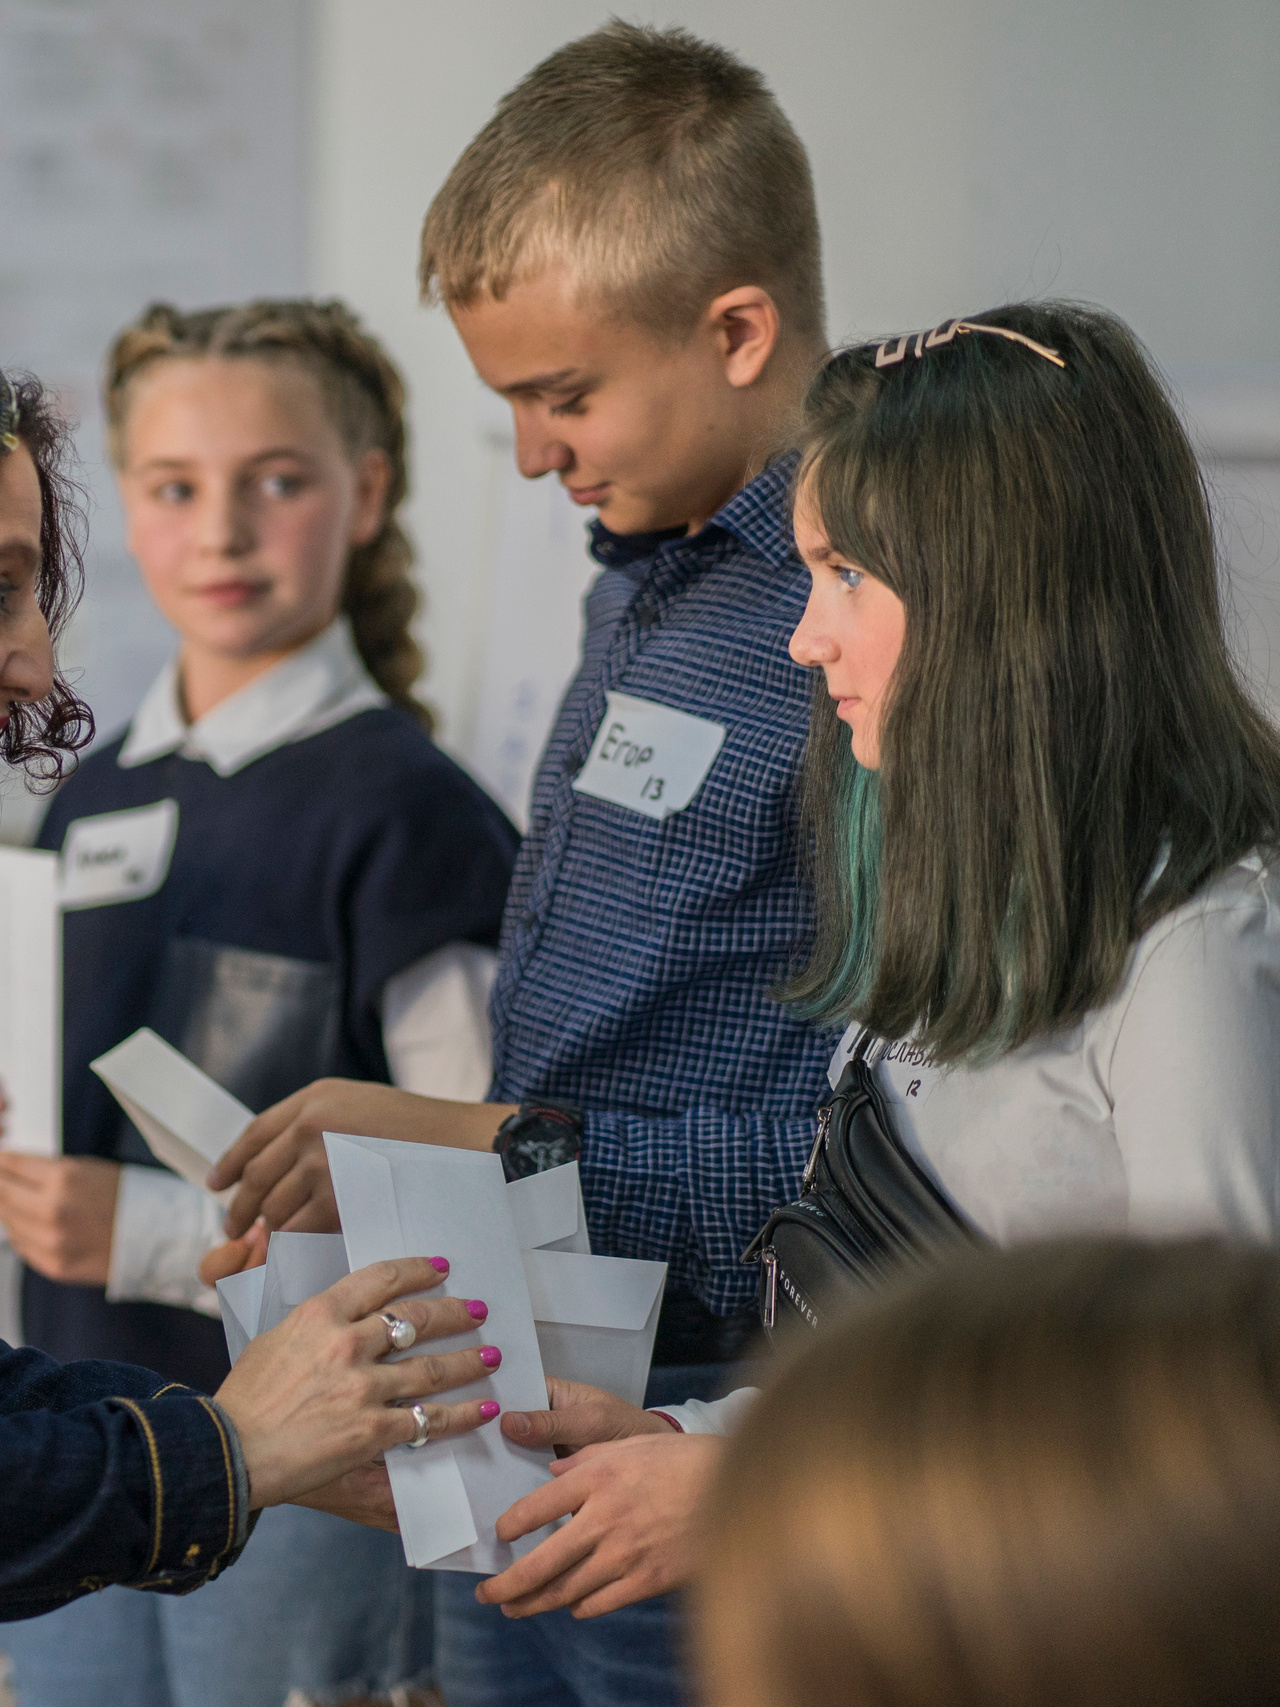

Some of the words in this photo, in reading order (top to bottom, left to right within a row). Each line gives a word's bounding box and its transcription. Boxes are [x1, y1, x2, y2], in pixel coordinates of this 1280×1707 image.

[639, 775, 665, 800] 13
[905, 1079, 922, 1097] 12
[779, 1269, 819, 1329] FOREVER
